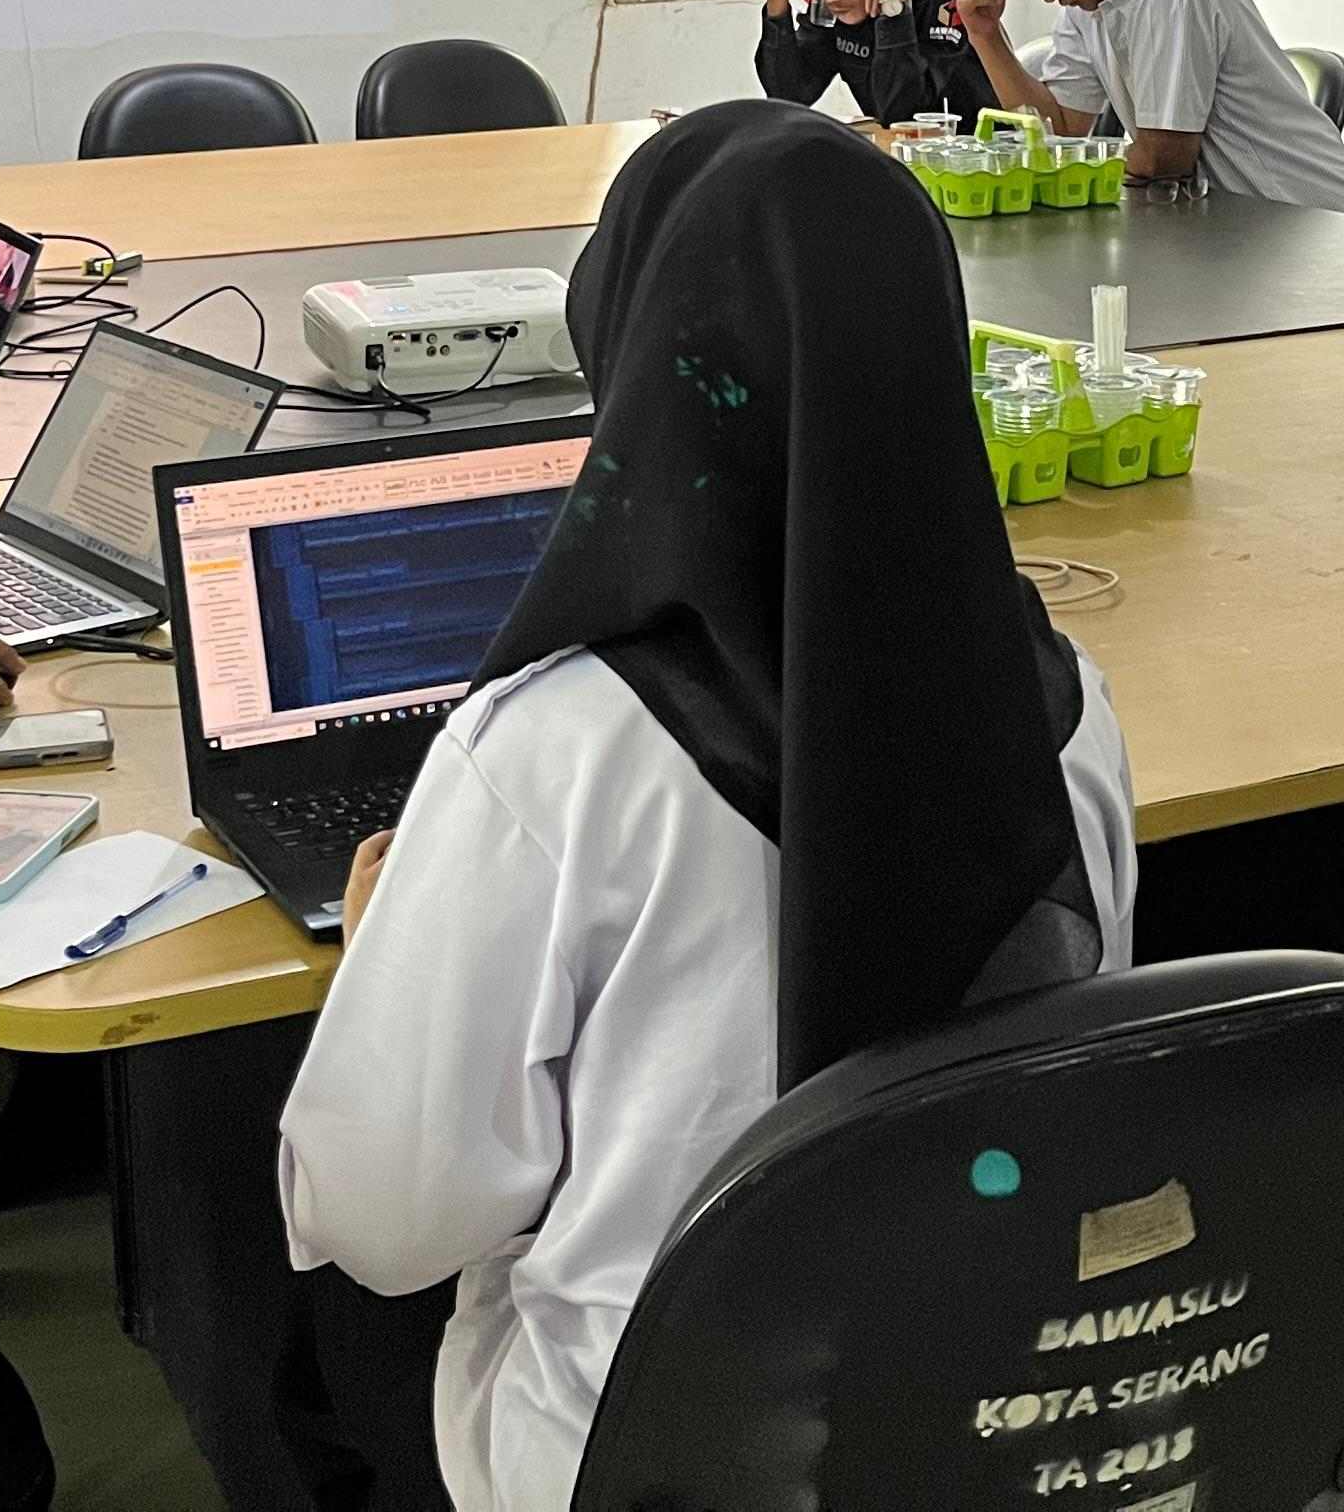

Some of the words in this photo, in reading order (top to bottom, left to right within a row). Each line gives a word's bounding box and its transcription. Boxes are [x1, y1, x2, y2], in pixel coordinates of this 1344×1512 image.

[1035, 1272, 1249, 1352] BAWASLU
[974, 1385, 1099, 1431] KOTA
[1106, 1333, 1271, 1410] SERANG
[1033, 1457, 1088, 1496] TA
